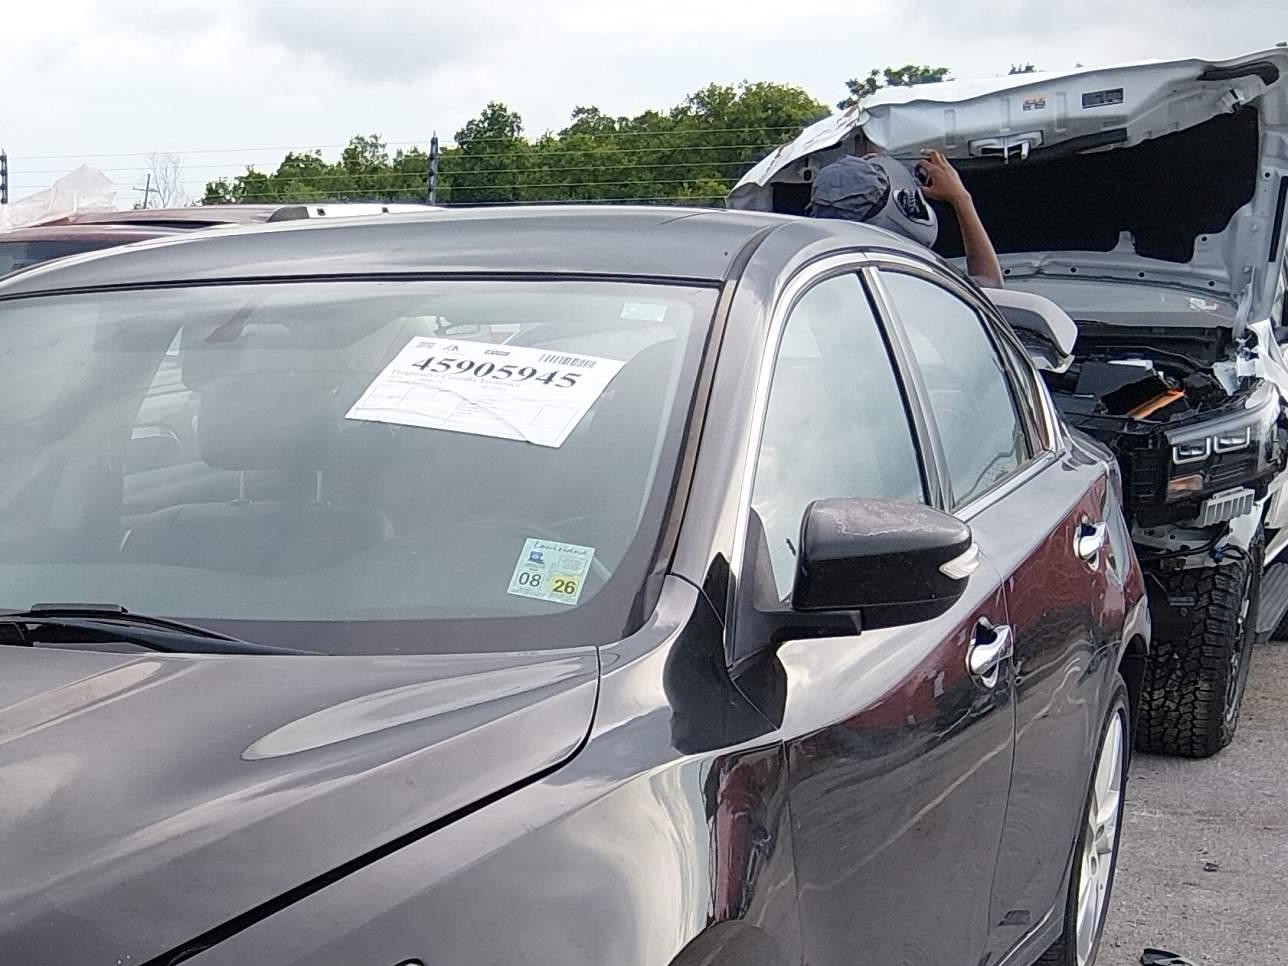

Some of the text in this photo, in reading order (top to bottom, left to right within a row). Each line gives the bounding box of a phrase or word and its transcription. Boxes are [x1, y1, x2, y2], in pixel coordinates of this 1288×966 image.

[411, 355, 582, 389] 45905945
[518, 572, 542, 587] 08
[552, 578, 577, 595] 26
